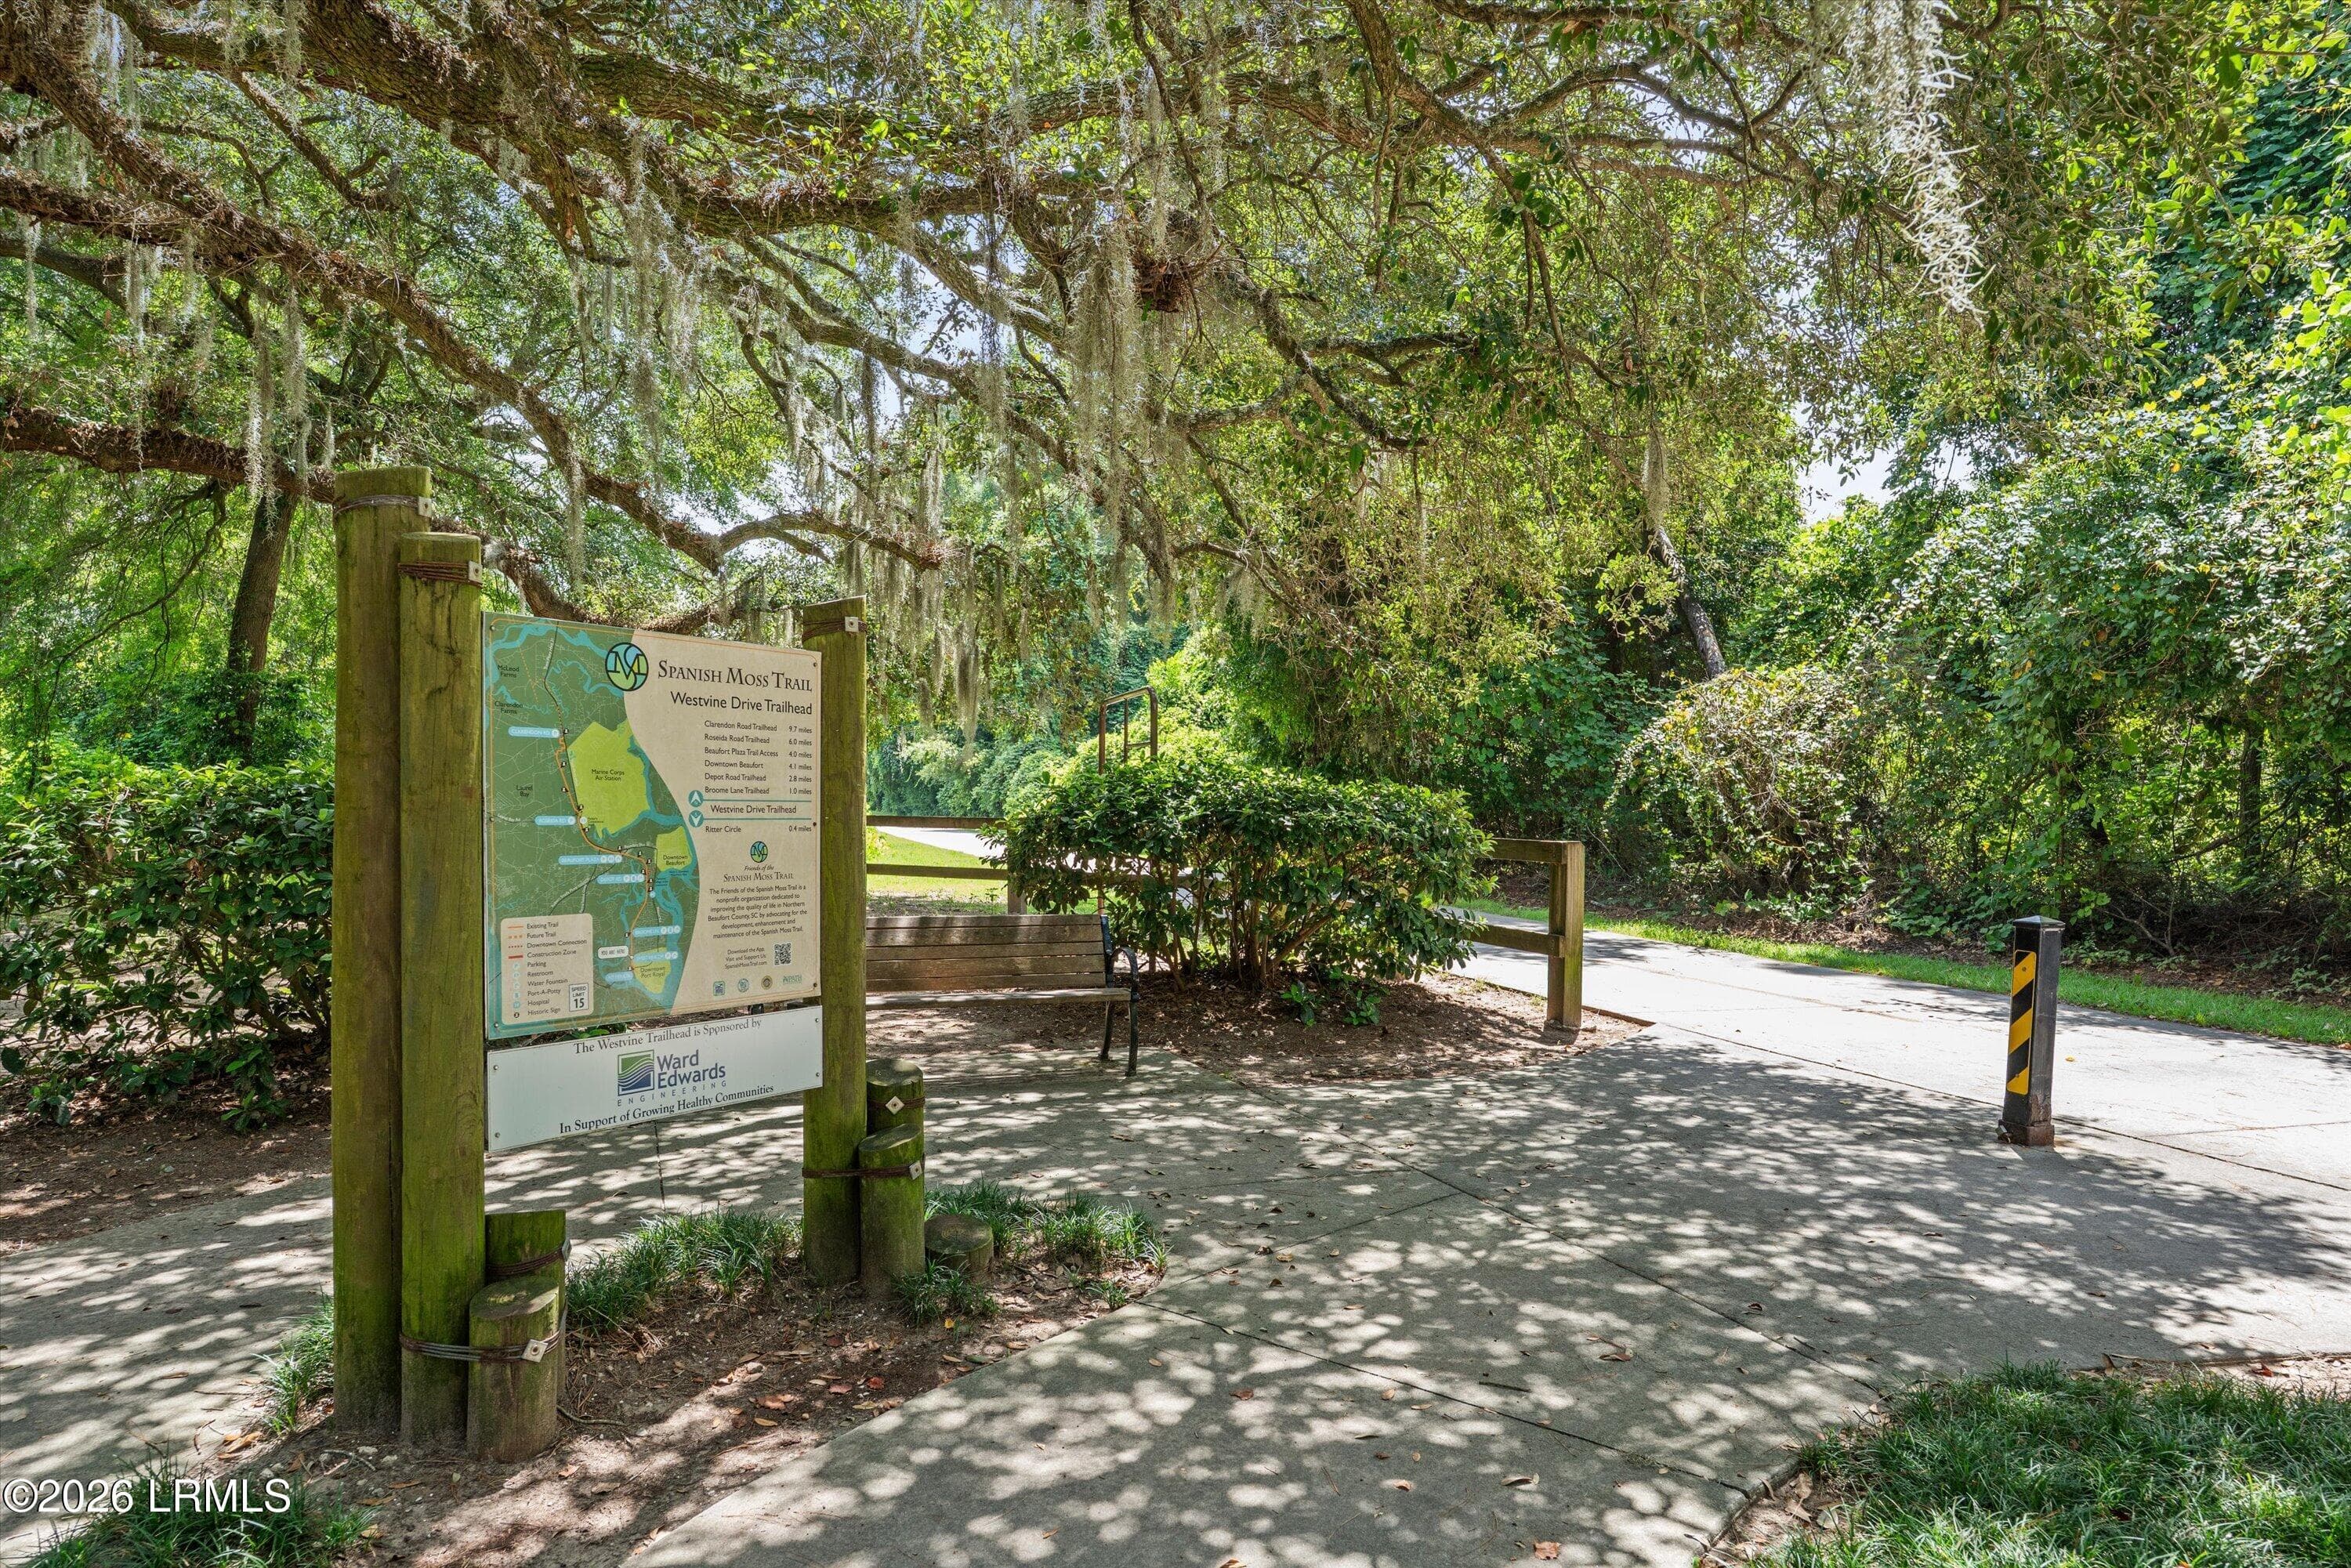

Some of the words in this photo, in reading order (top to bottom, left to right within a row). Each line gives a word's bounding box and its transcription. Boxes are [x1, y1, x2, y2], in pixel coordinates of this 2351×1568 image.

[658, 660, 722, 683] SPANISH
[726, 667, 769, 688] MOSS
[772, 671, 812, 692] TRAIL
[670, 691, 726, 708] Westvine
[731, 696, 763, 711] Drive
[765, 699, 812, 715] Trailhead
[705, 720, 735, 729] Clarendon
[737, 722, 752, 730] Road
[752, 723, 777, 732] Trailhead
[710, 804, 744, 813] Westvine
[746, 805, 765, 813] Drive
[766, 805, 797, 813] Trailhead
[723, 874, 752, 882] SPANISH
[754, 872, 773, 881] MOSS
[773, 871, 794, 880] TRAIL
[712, 931, 744, 940] maintenance
[527, 988, 561, 997] Port-A-Potty
[574, 998, 585, 1009] 15
[573, 1042, 595, 1055] The
[597, 1036, 643, 1051] Westvine
[645, 1027, 690, 1044] Trailhead
[694, 1027, 701, 1037] is
[703, 1019, 749, 1036] Sponsored
[752, 1018, 762, 1030] by
[657, 1048, 699, 1072] Ward
[657, 1063, 726, 1090] Edwards
[617, 1080, 727, 1106] ENGINEERING
[560, 1122, 571, 1134] In
[574, 1114, 618, 1132] Support
[619, 1109, 630, 1122] of
[632, 1103, 675, 1121] Growing
[677, 1096, 713, 1116] Healthy
[715, 1084, 774, 1104] Communities
